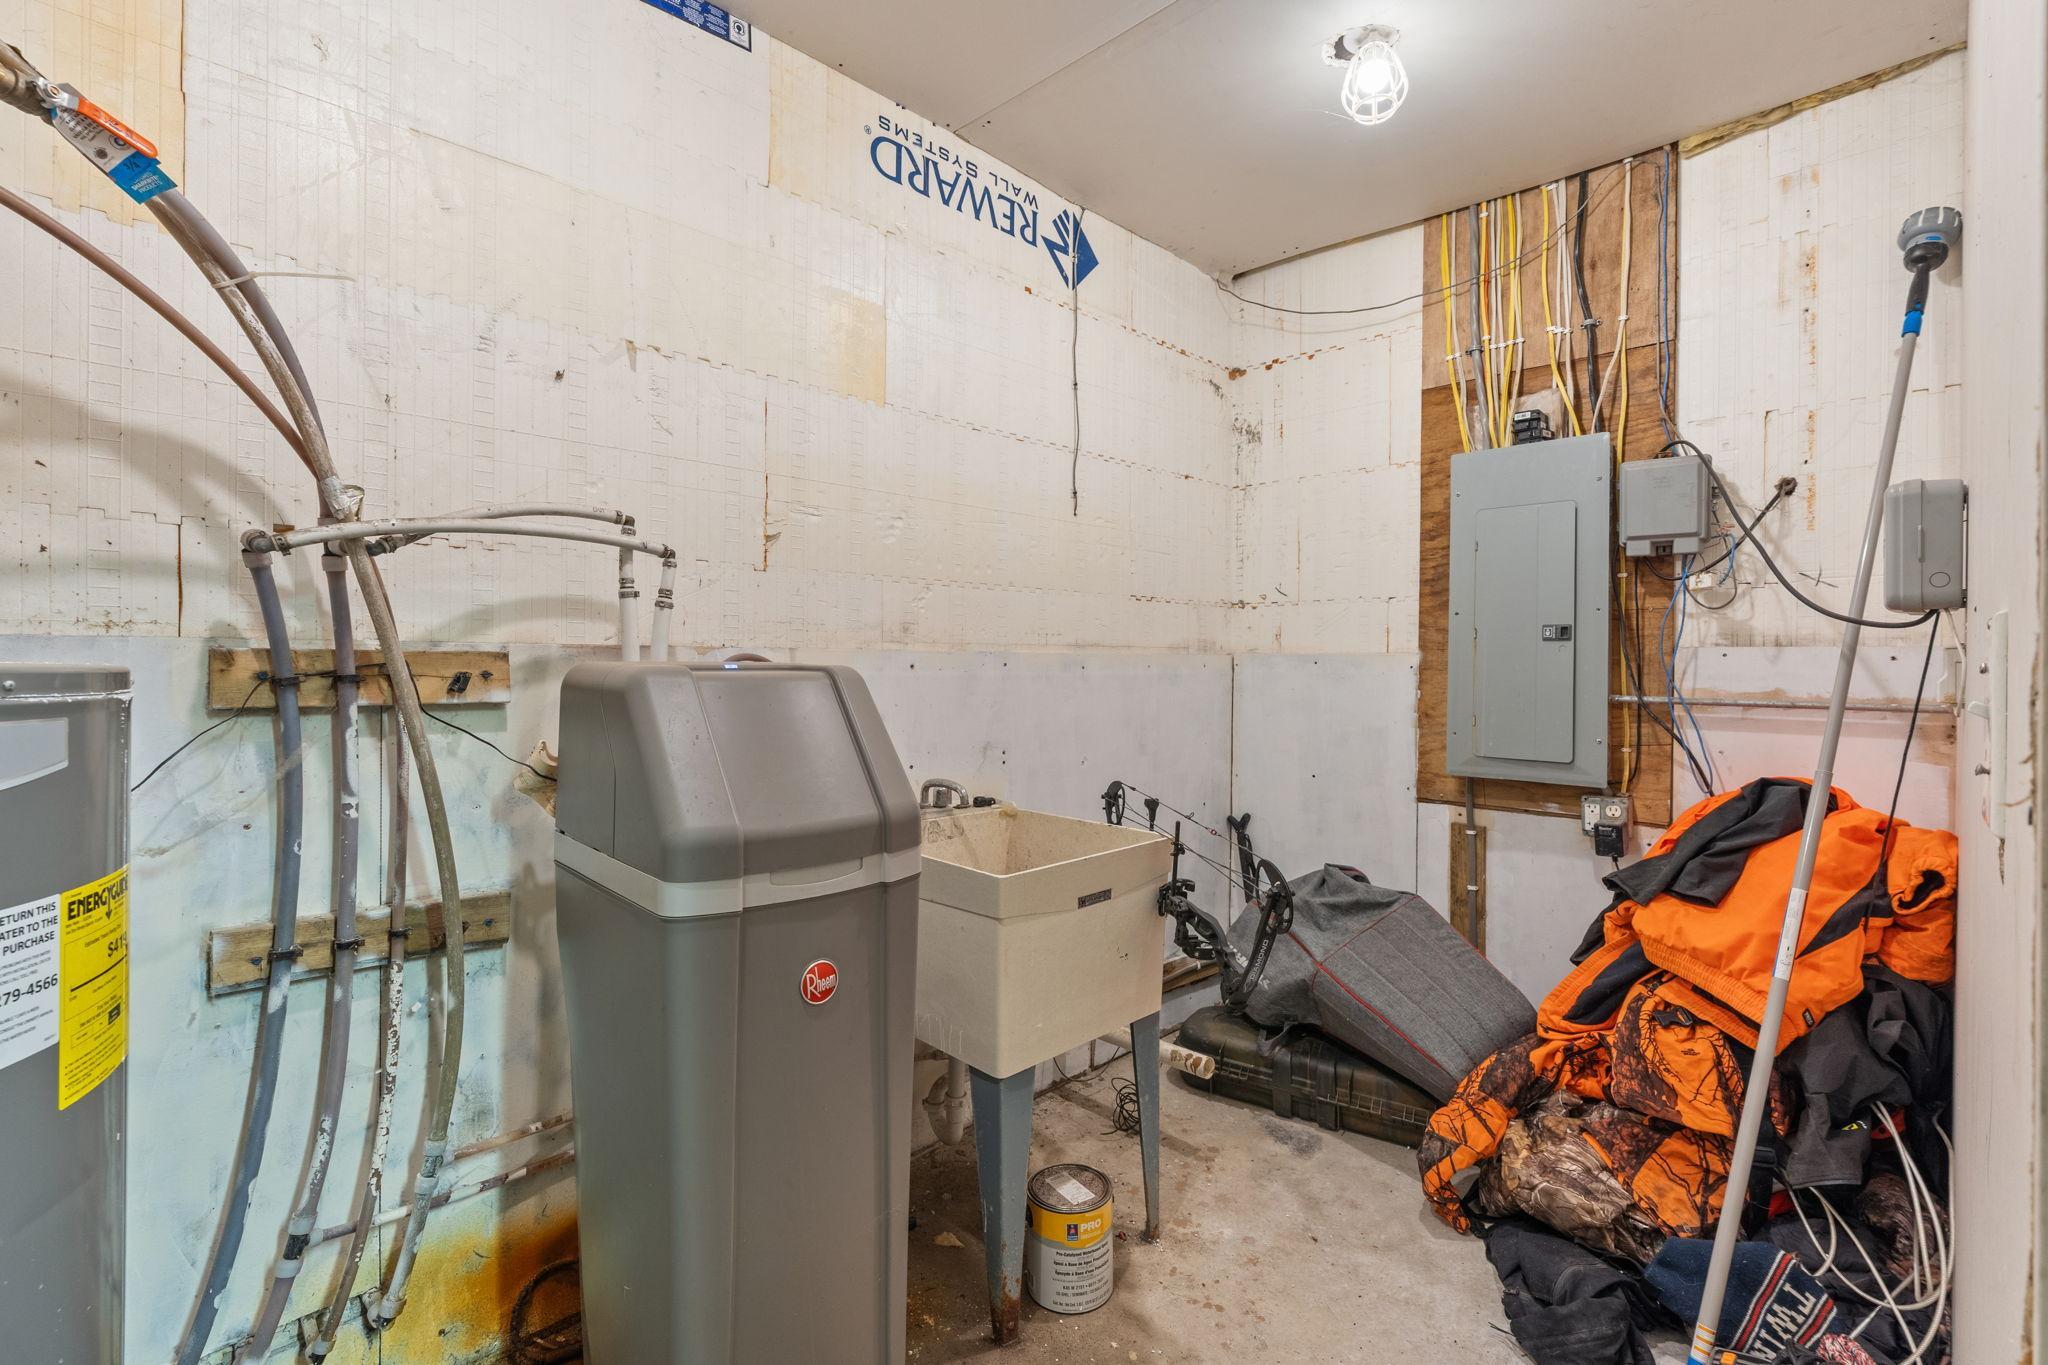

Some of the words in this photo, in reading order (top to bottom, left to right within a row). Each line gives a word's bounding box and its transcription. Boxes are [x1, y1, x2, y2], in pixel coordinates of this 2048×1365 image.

[878, 115, 978, 179] SYSTEMS
[870, 136, 1039, 248] REWARD
[989, 171, 1039, 210] WALL
[26, 921, 40, 934] TO
[41, 915, 59, 929] THE
[36, 902, 56, 916] THIS
[3, 931, 56, 957] PURCHASE
[1250, 939, 1269, 980] DIAMOND
[0, 973, 59, 1008] 79-4566
[805, 966, 837, 1000] Rheem
[1080, 1219, 1102, 1233] PRO
